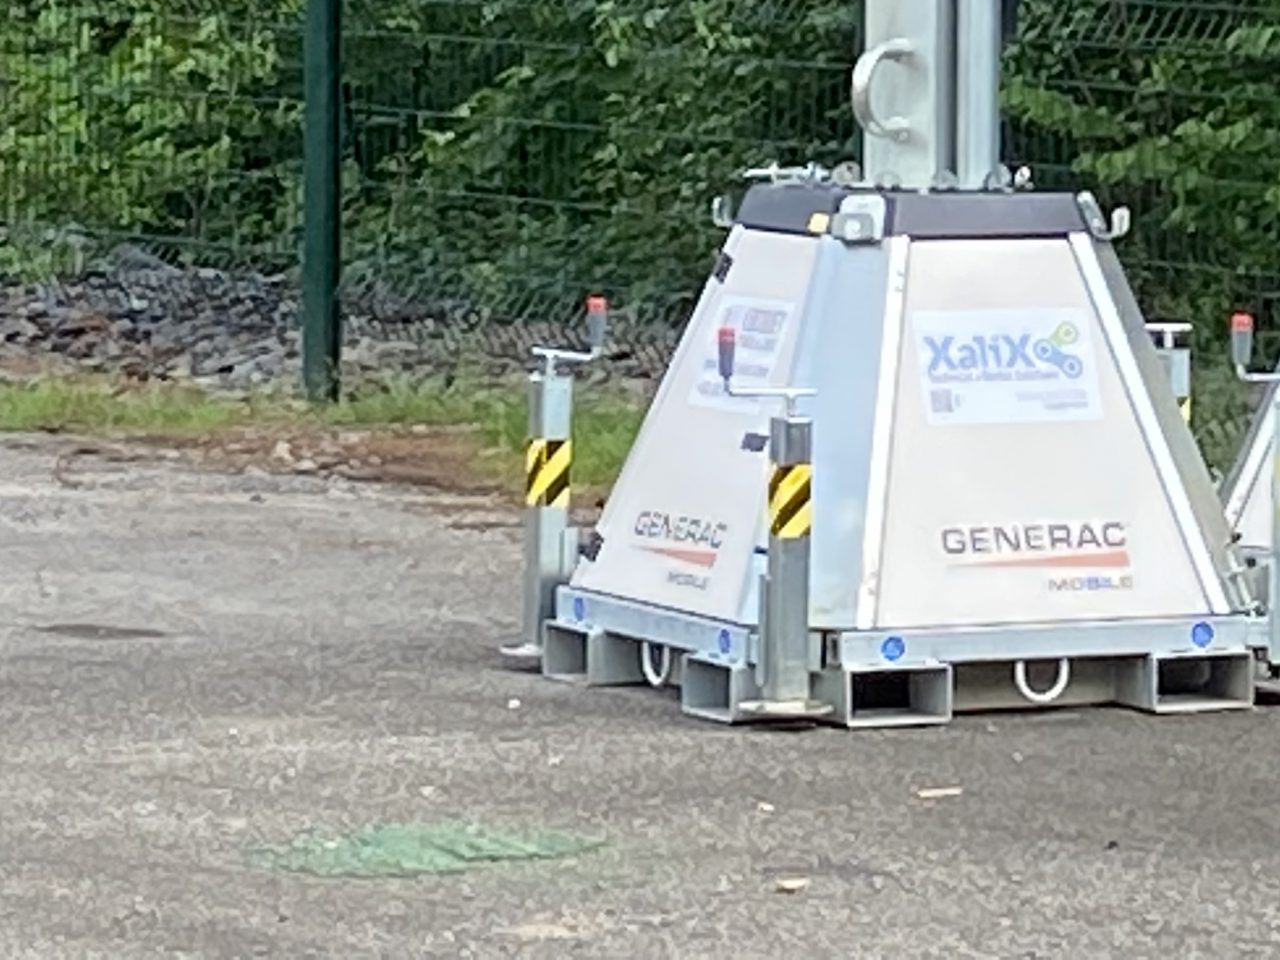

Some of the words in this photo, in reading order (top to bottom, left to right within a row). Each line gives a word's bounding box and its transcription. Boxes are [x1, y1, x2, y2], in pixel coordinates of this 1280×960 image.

[922, 332, 1037, 376] XaliX
[634, 510, 728, 550] GENERAC
[940, 521, 1128, 556] GENERAC
[1048, 574, 1134, 592] MOBILE
